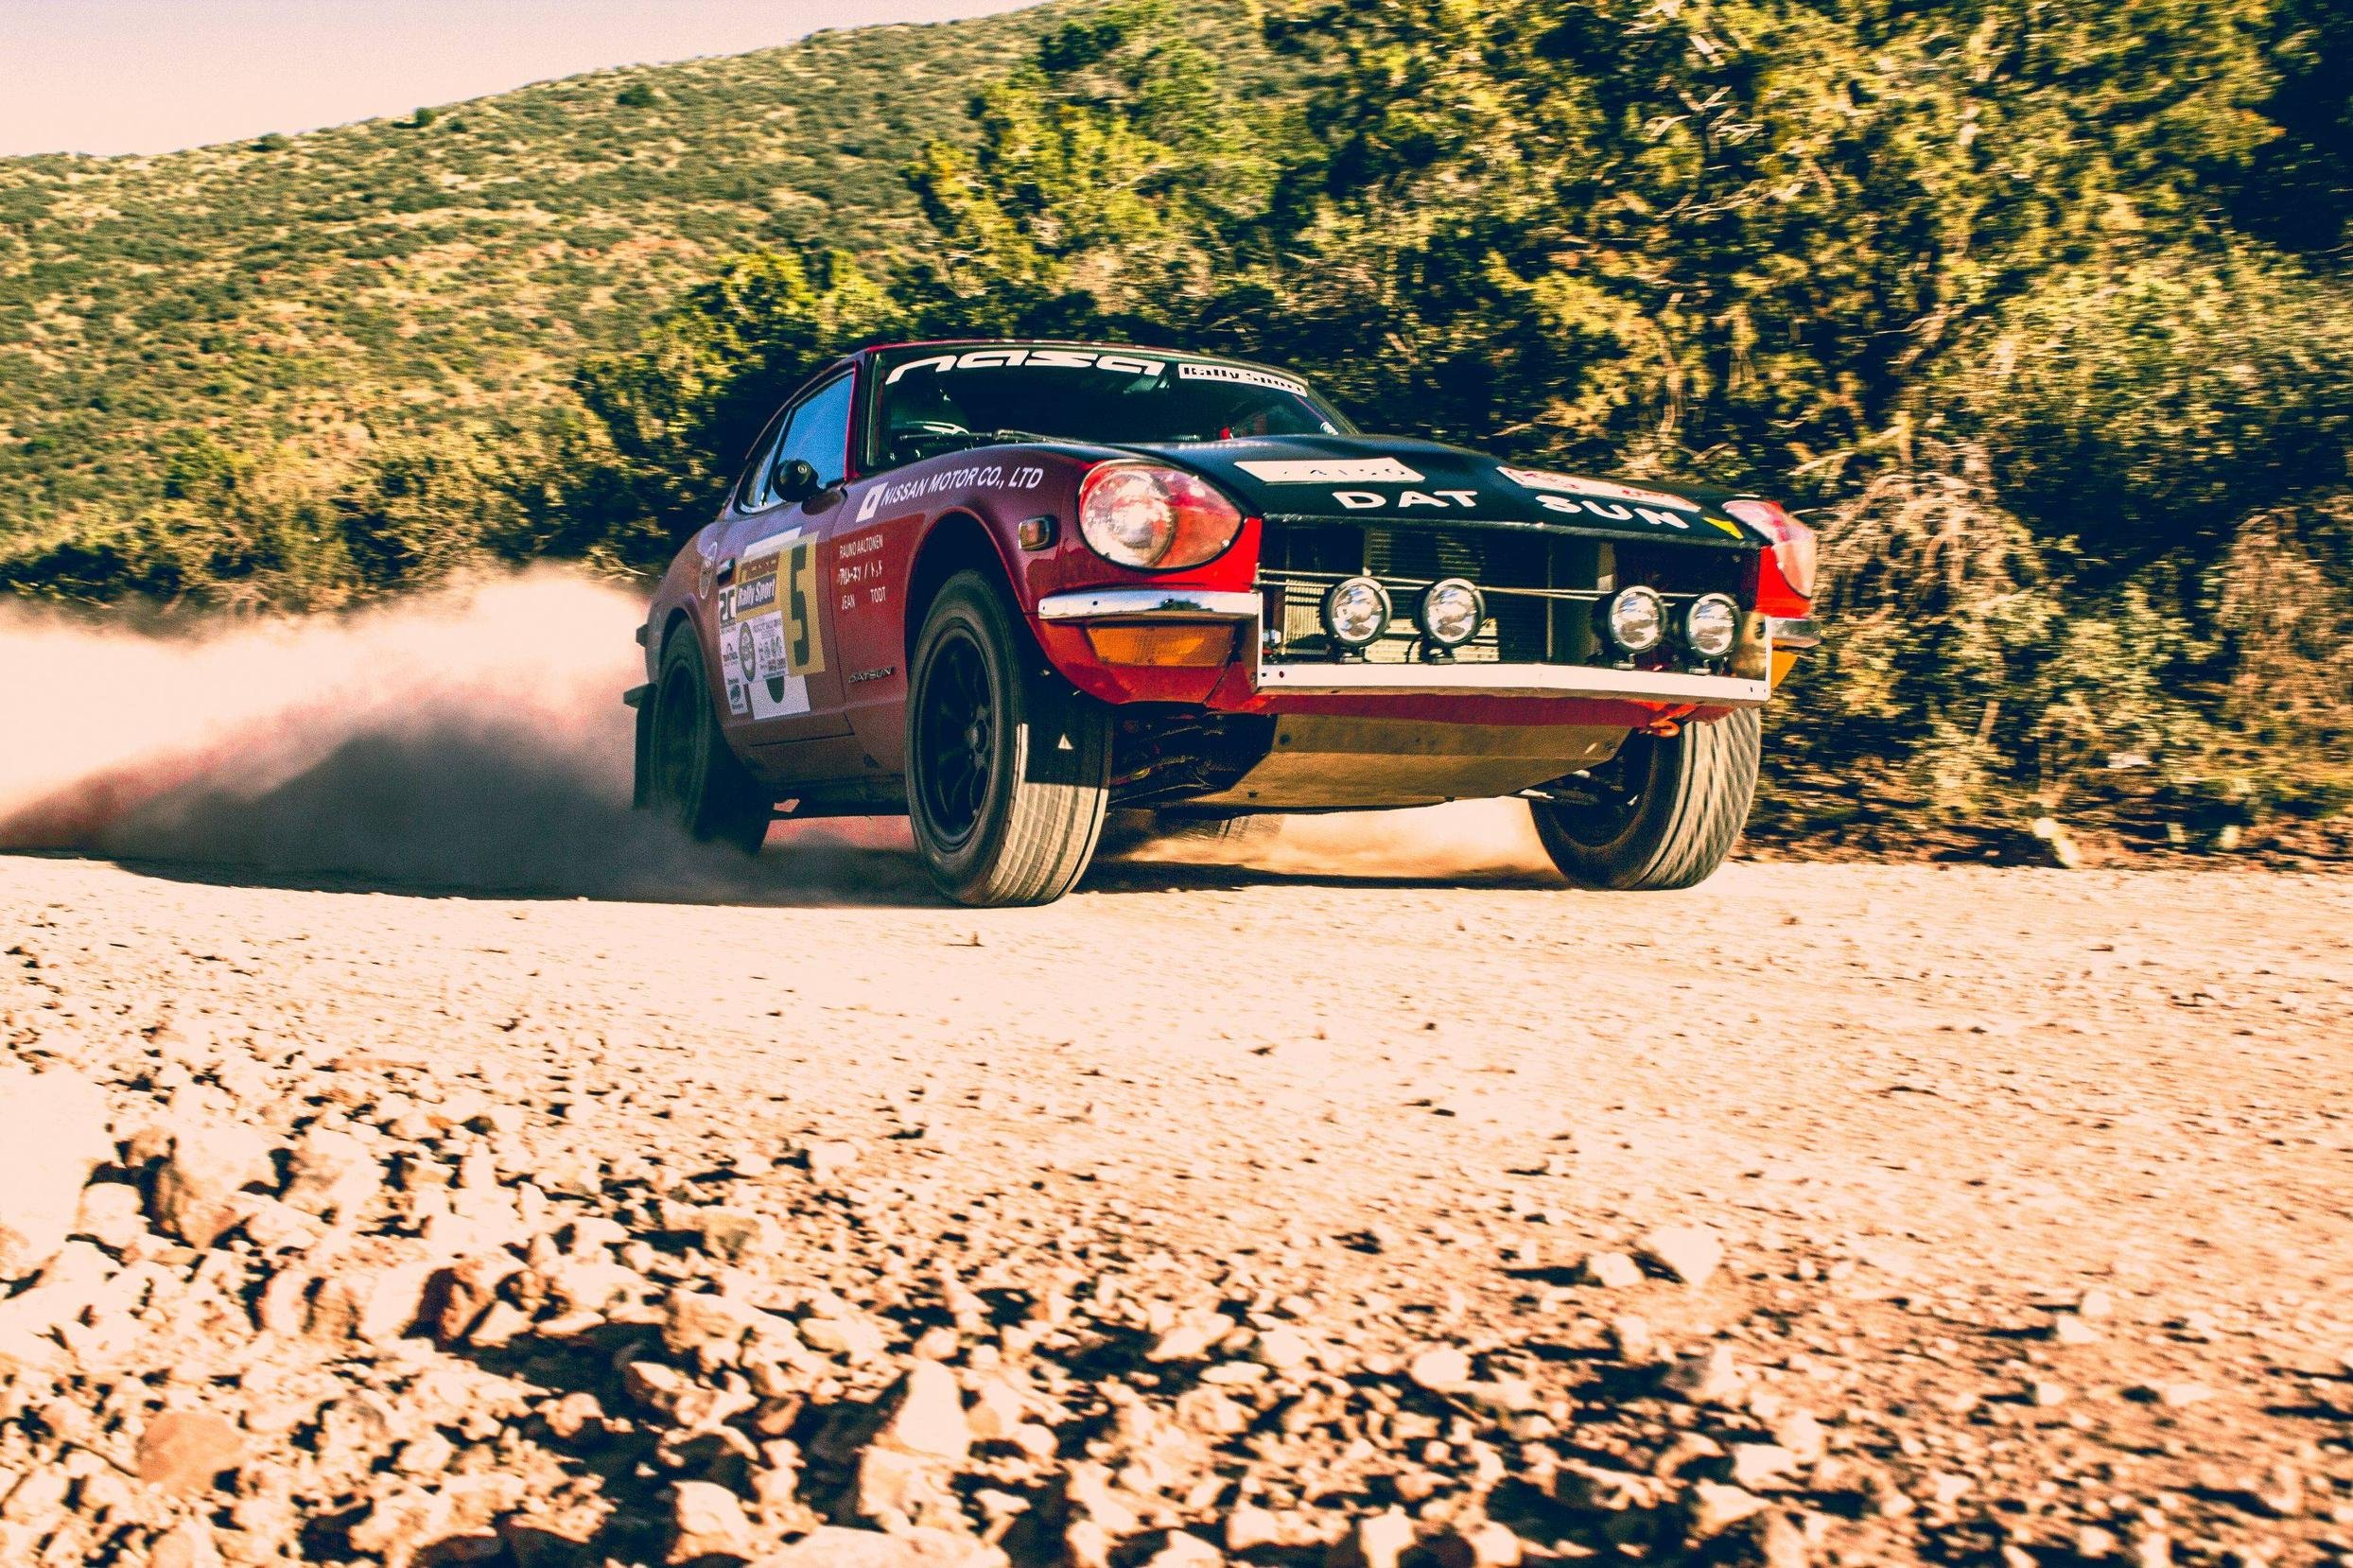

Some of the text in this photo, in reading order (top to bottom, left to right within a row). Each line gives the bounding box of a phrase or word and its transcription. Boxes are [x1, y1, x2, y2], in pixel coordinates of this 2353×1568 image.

[885, 350, 1166, 385] nasa
[880, 477, 931, 507] NISSAN
[928, 466, 980, 494] MOTOR
[1008, 466, 1044, 490] LTD
[1332, 490, 1690, 530] DAT SUN
[755, 578, 776, 602] Sport
[791, 542, 810, 667] 5
[842, 585, 886, 610] JEAN TODT
[848, 665, 896, 684] DATSUN
